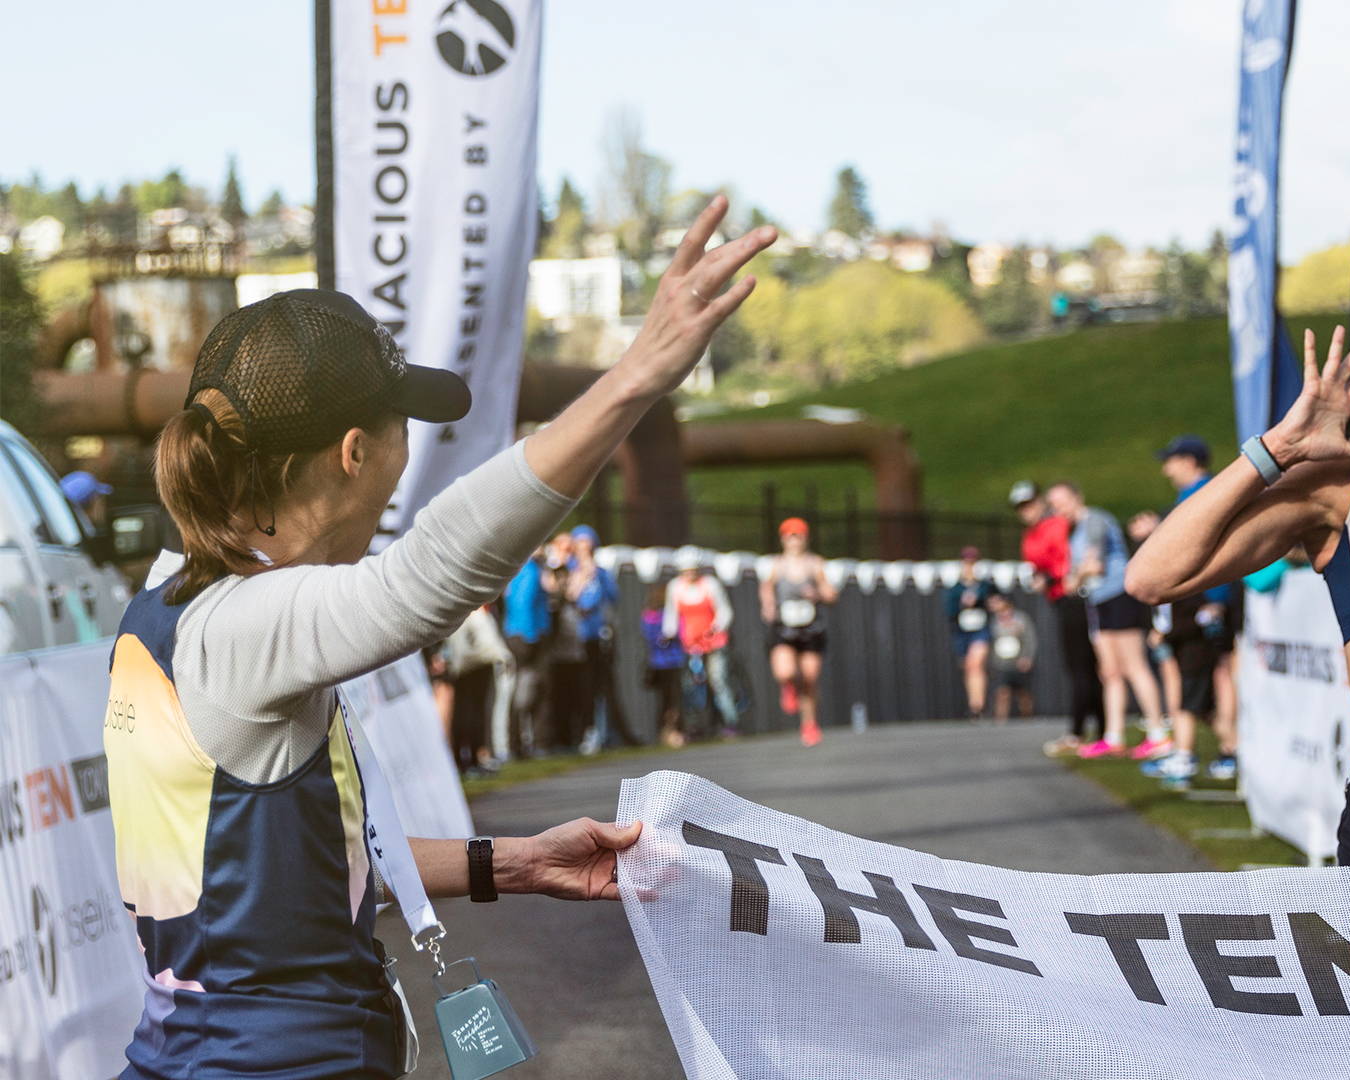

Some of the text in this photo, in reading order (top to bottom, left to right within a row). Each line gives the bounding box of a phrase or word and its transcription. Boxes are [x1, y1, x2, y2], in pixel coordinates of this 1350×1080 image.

[463, 114, 488, 165] BY
[24, 763, 77, 834] TEN
[682, 820, 1044, 978] THE
